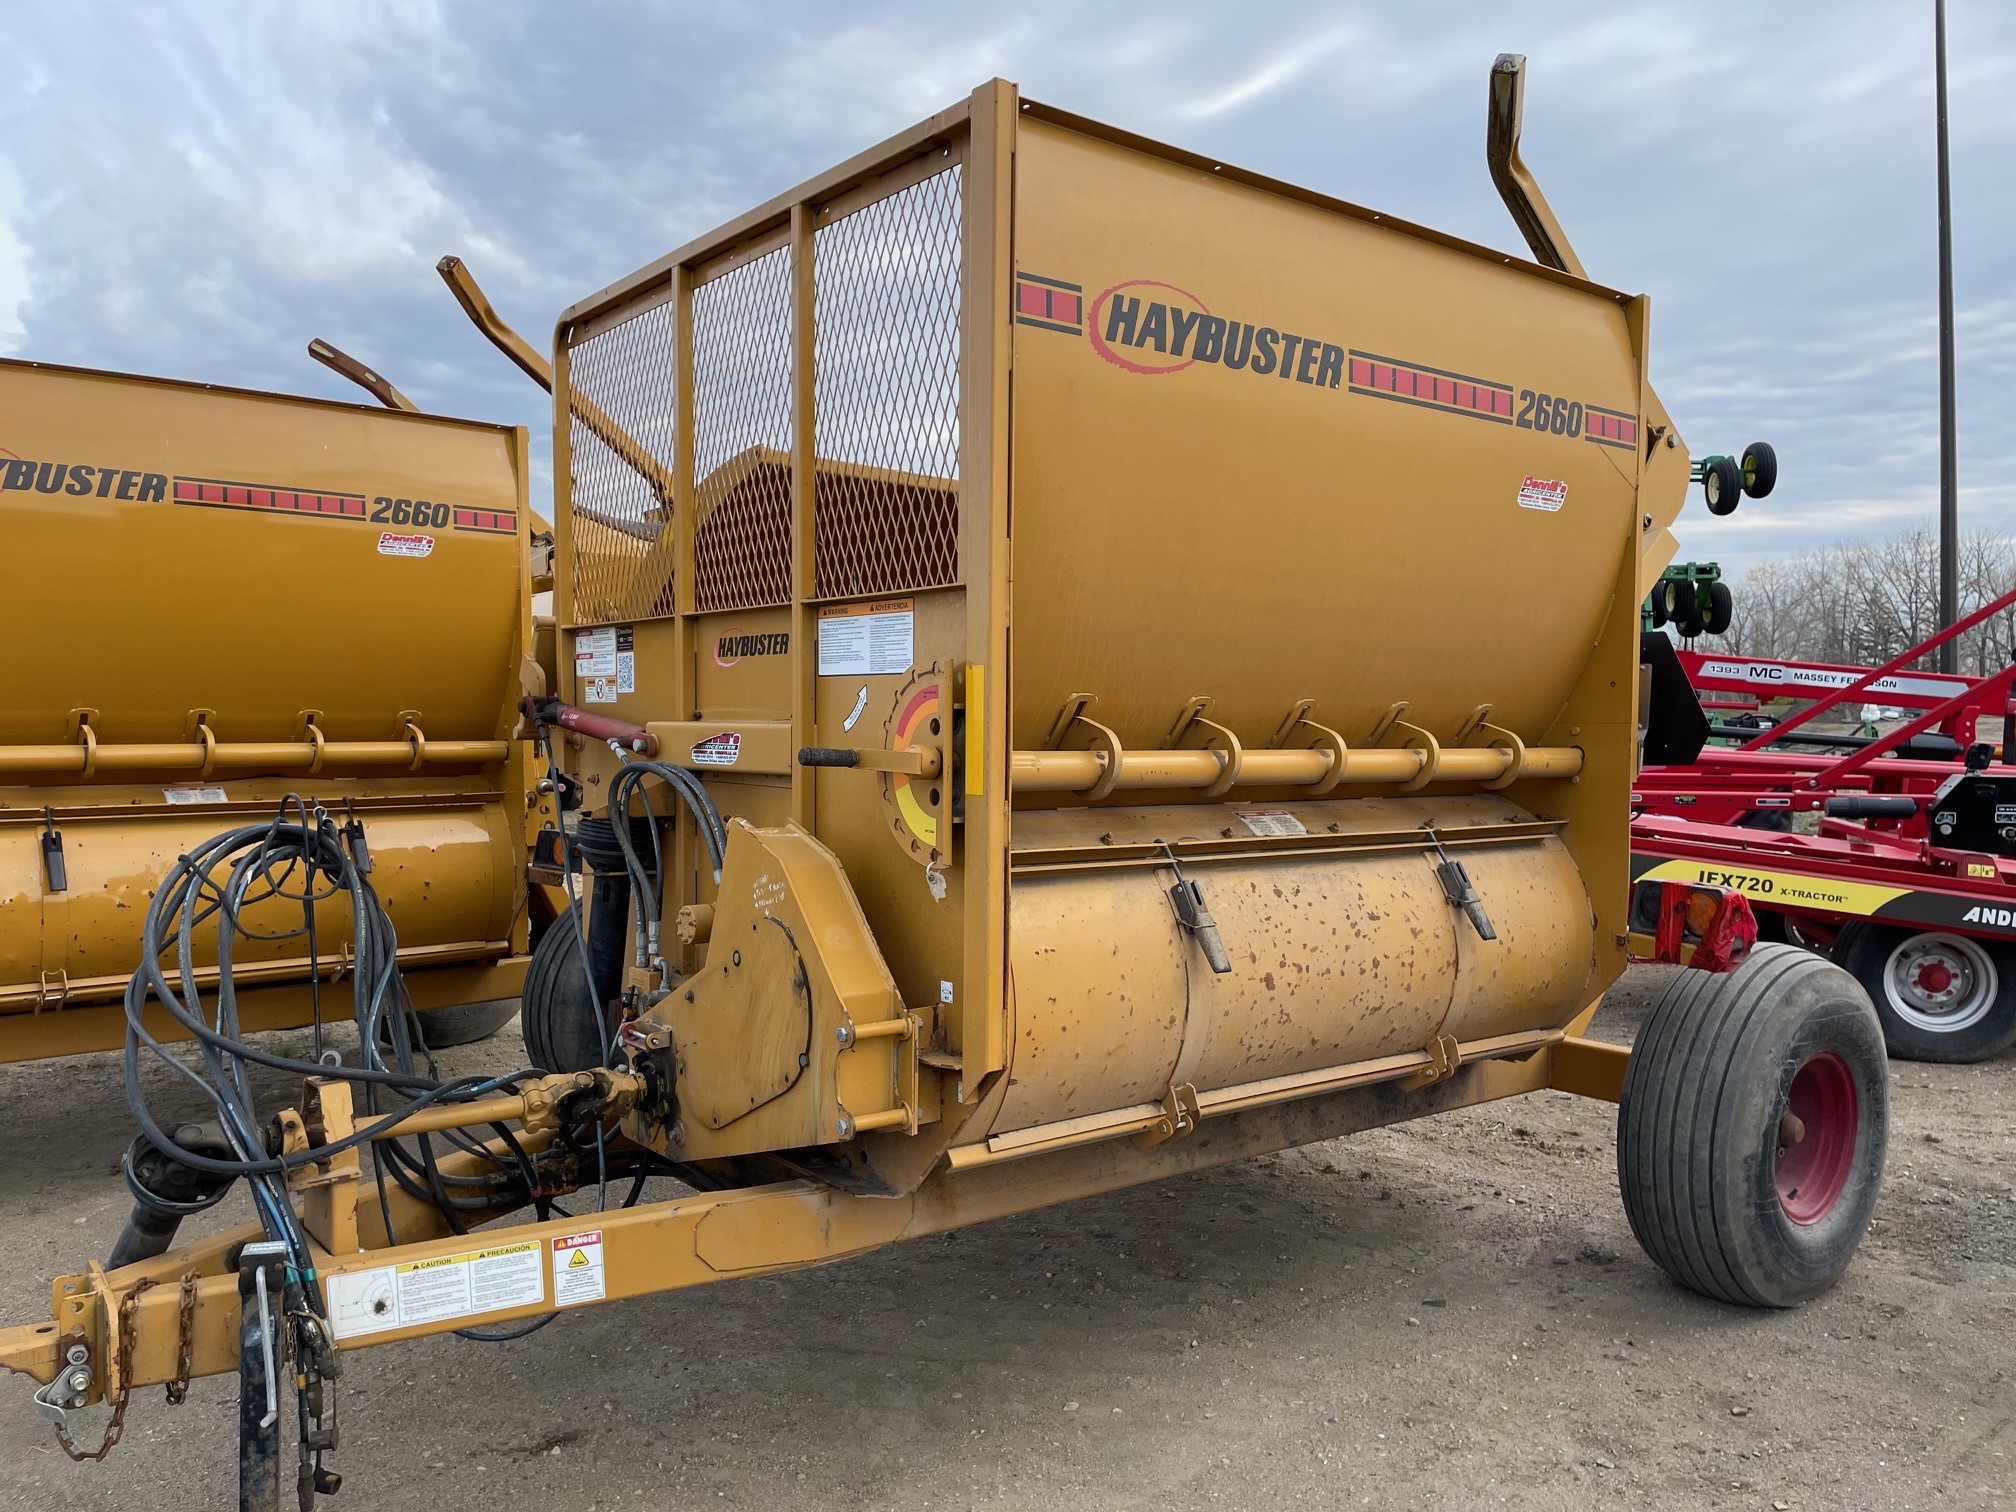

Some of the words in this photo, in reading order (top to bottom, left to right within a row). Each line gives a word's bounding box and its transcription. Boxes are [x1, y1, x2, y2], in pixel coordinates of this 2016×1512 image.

[1104, 293, 1344, 389] HAYBUSTER
[1515, 389, 1584, 438] 2660
[0, 459, 168, 503] BUSTER
[370, 497, 451, 529] 2660
[828, 607, 849, 615] WARNING
[875, 602, 909, 612] ADVERTENCIA
[717, 633, 789, 658] HAYBUSTER
[1709, 664, 1740, 676] 1393
[1749, 666, 1783, 680] MC
[1793, 672, 1838, 683] MASSEY
[567, 1234, 598, 1246] DANGER
[486, 1244, 531, 1257] PRECAUCIÓN
[420, 1258, 452, 1269] CAUTION
